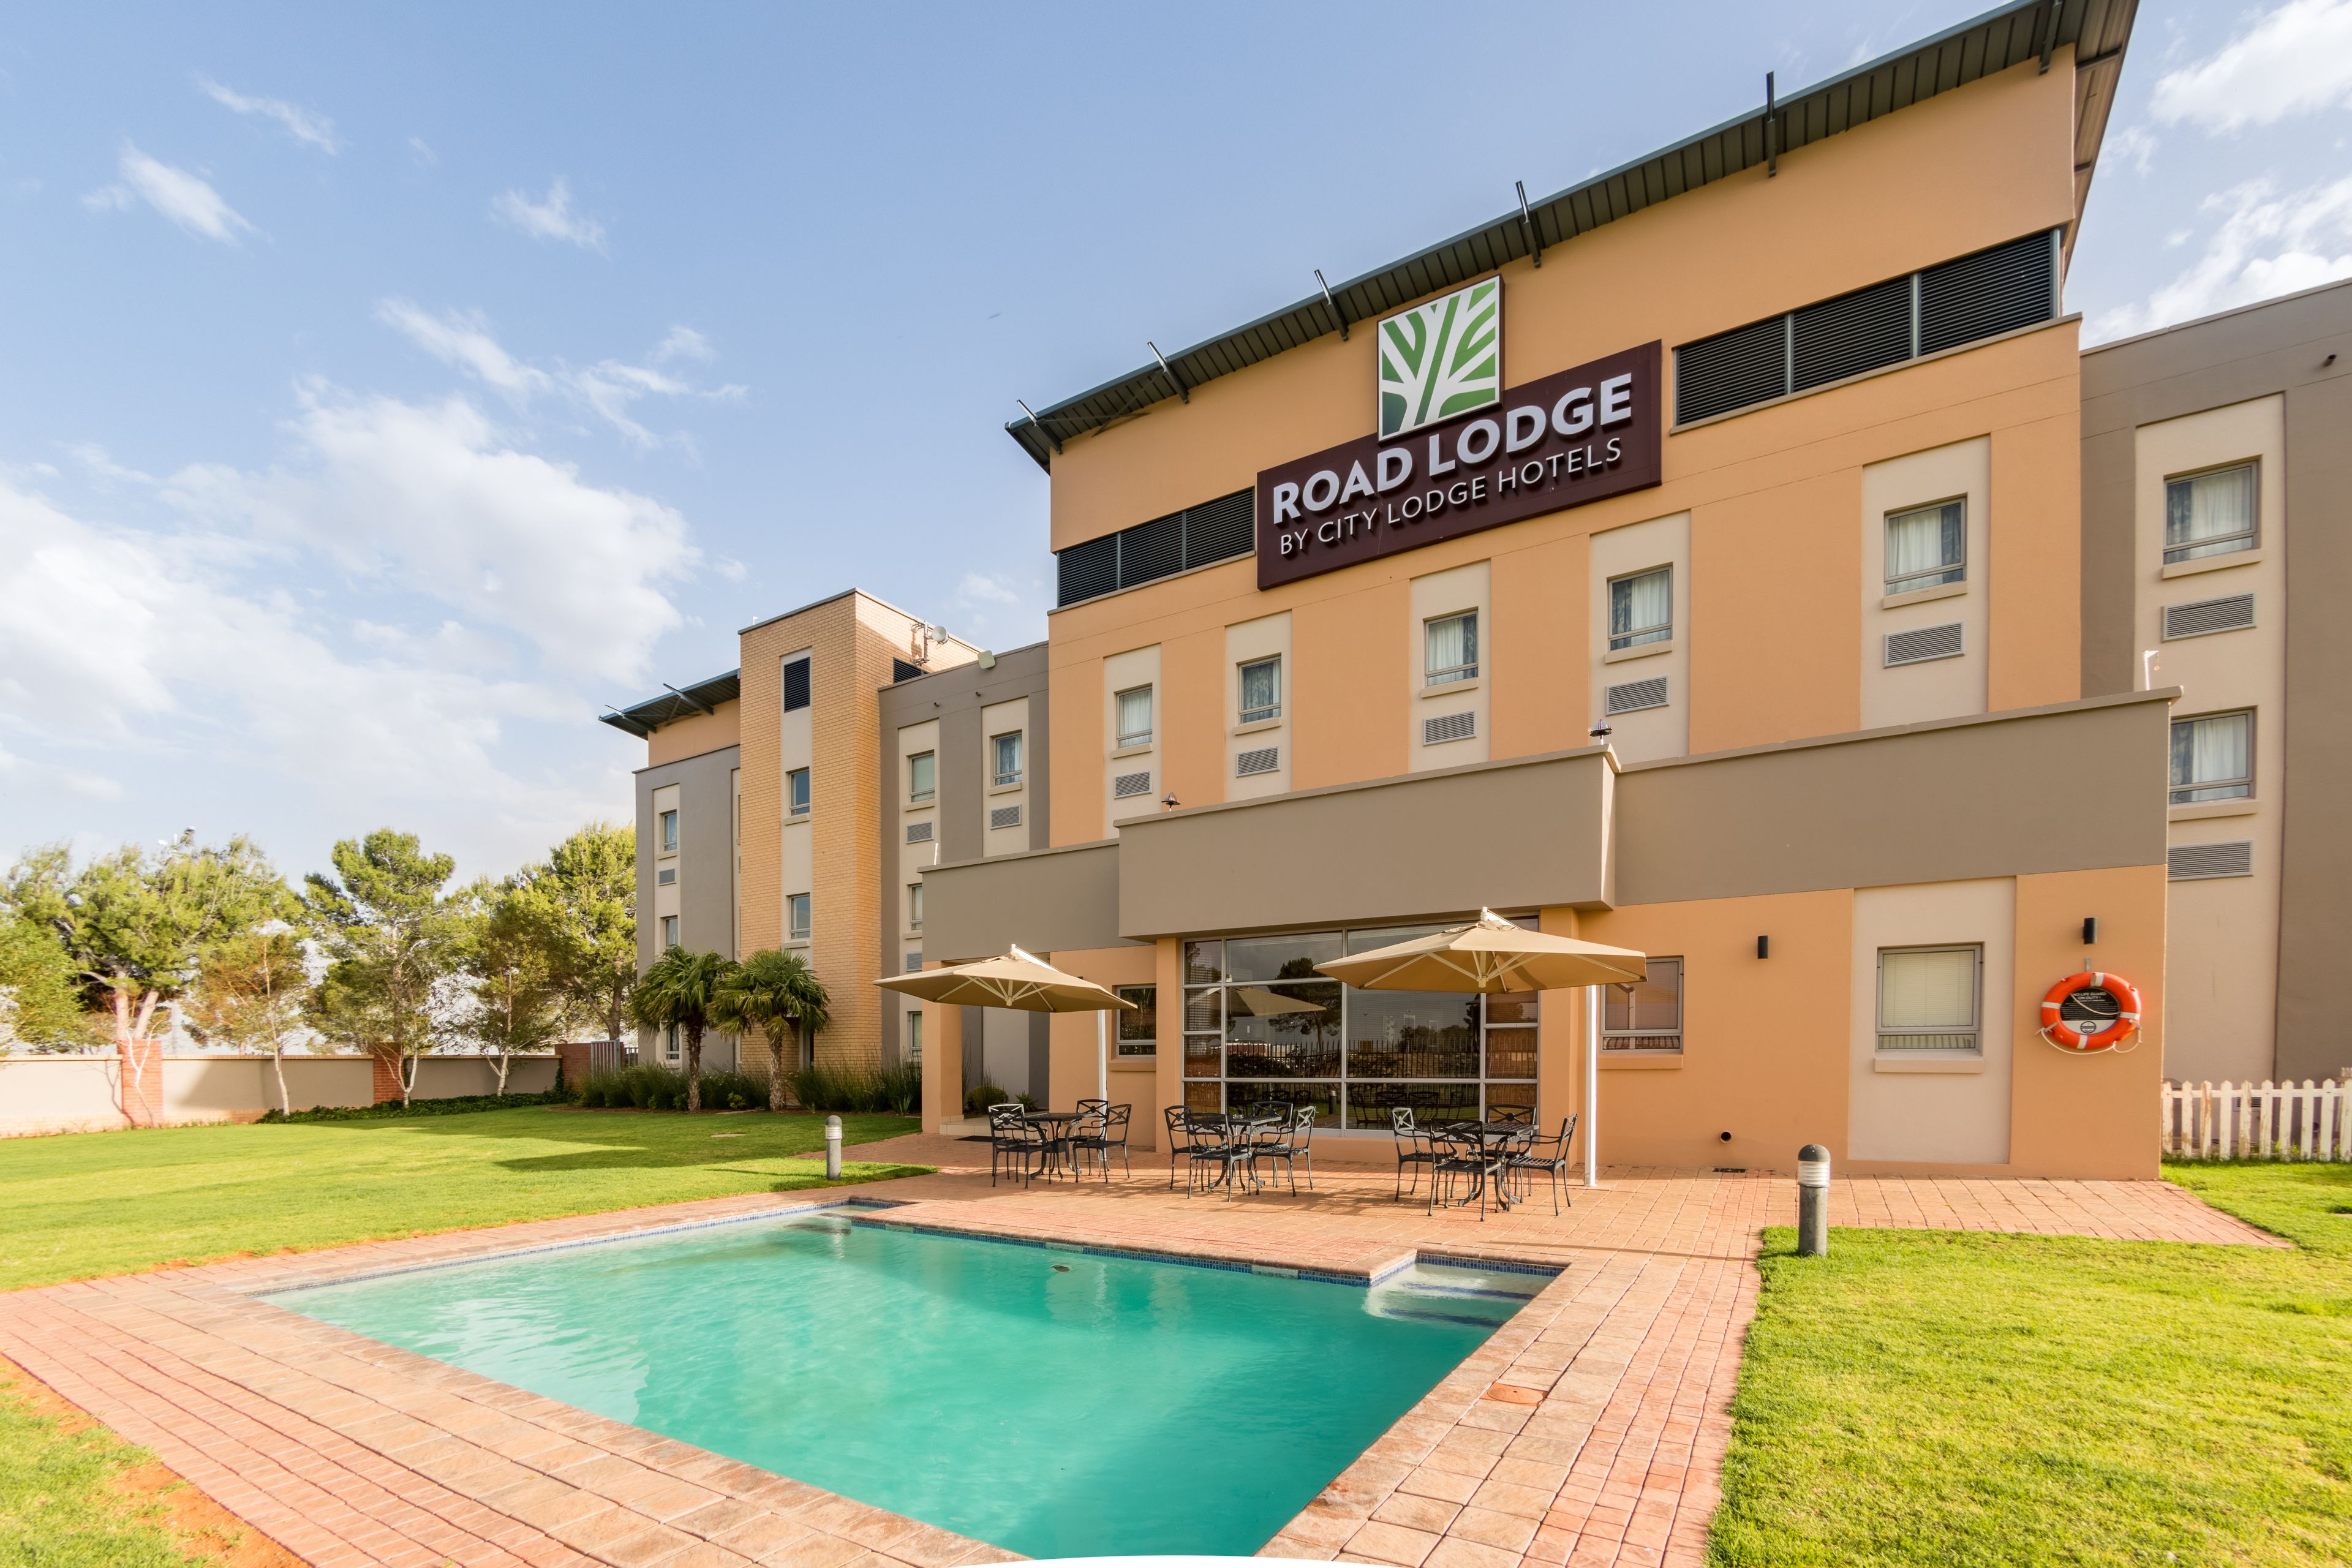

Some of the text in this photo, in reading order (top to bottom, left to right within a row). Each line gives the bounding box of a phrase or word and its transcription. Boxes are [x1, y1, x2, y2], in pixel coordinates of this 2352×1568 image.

[1273, 372, 1632, 525] ROAD LODGE
[1280, 437, 1621, 556] BY CITY LODGE HOTELS
